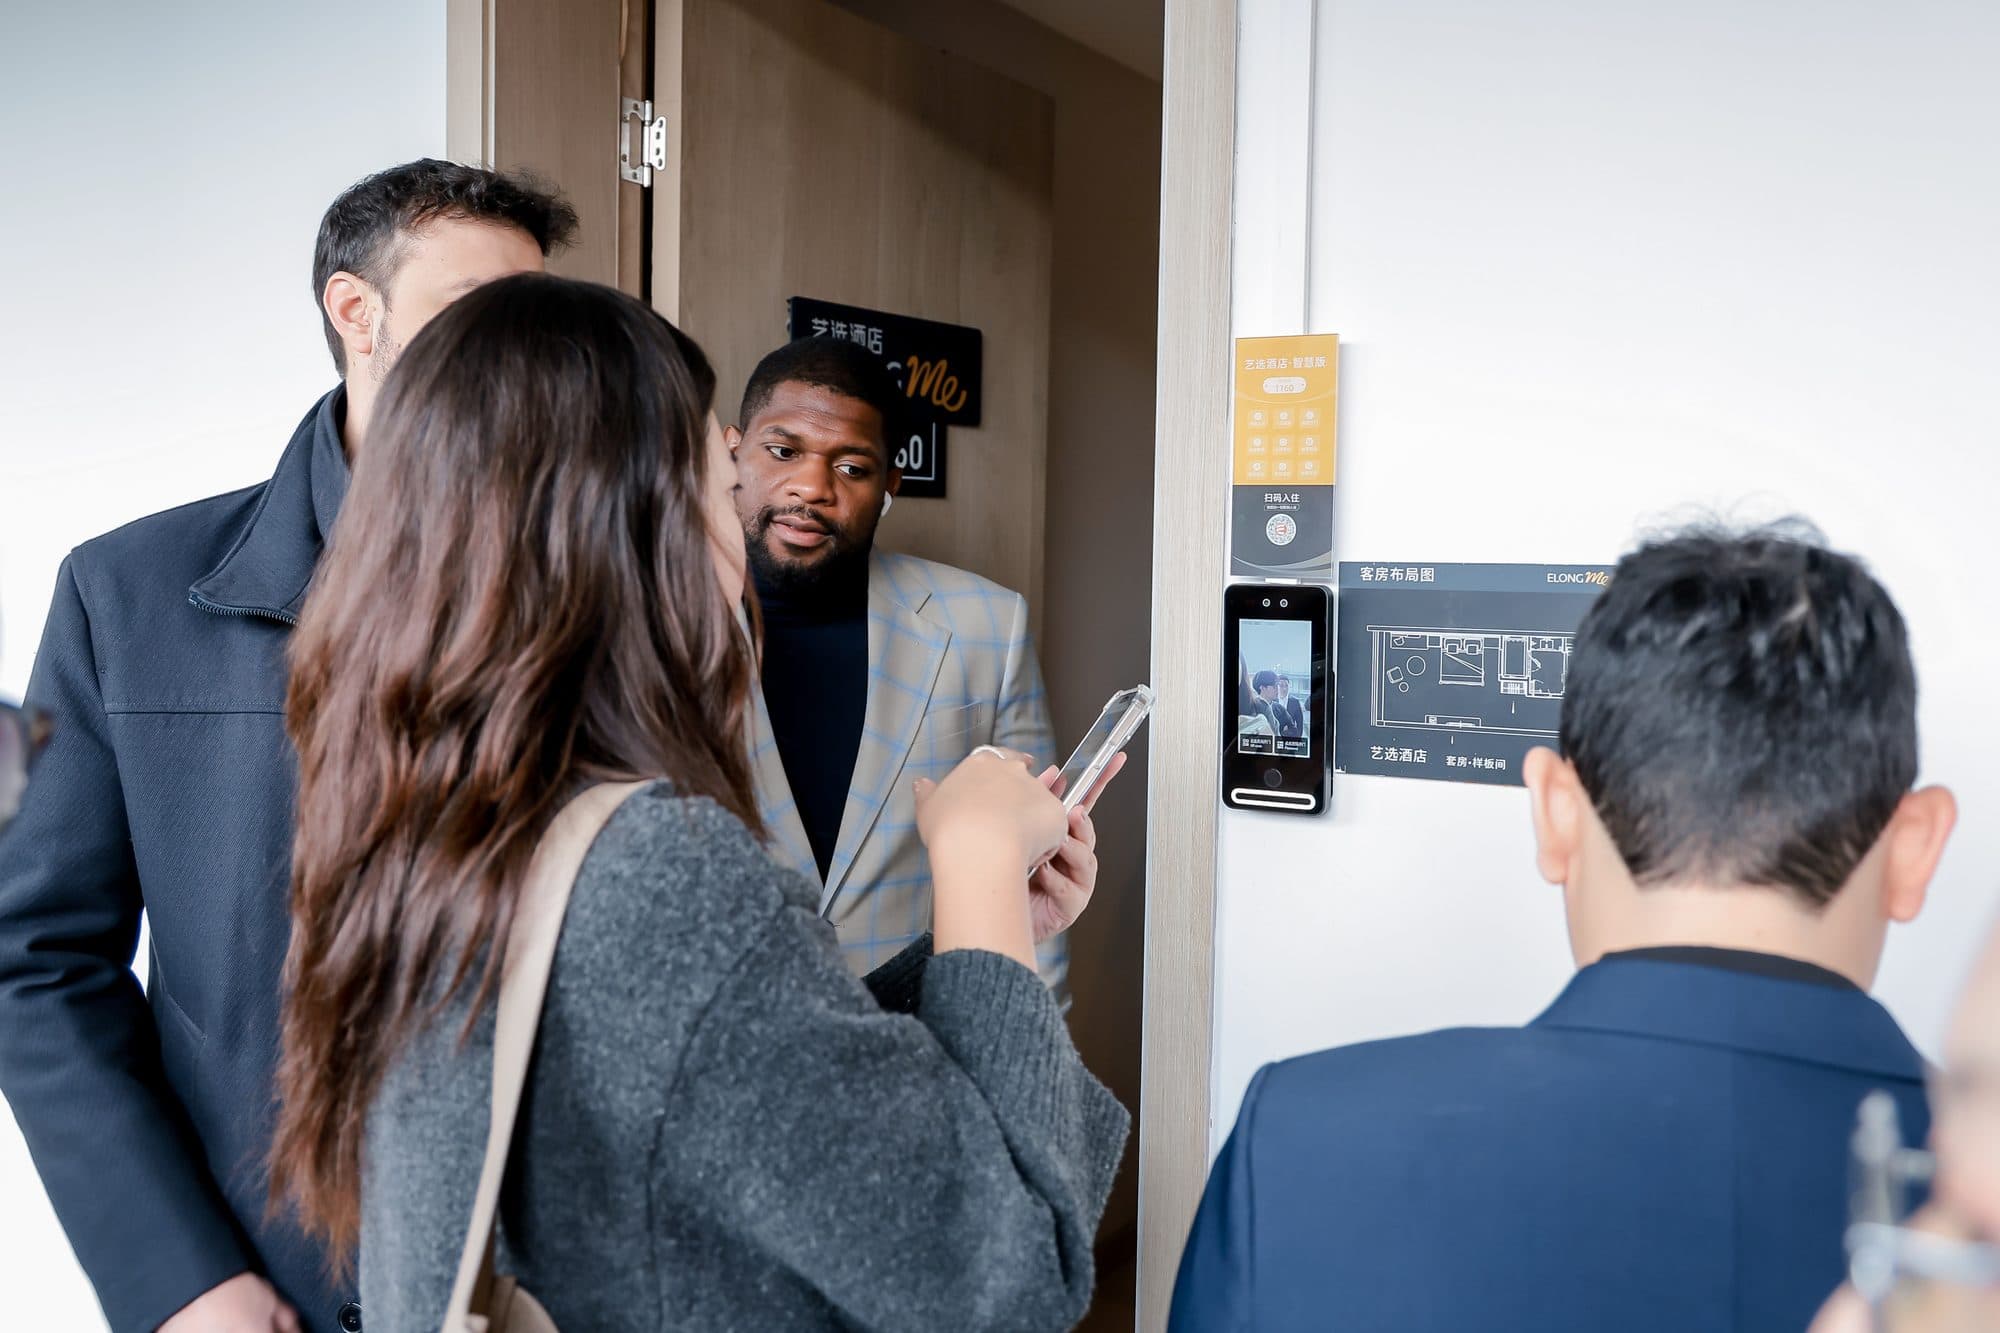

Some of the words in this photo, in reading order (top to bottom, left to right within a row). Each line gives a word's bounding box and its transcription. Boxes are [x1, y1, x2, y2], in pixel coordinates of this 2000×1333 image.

[1264, 493, 1300, 503] 扫码入住
[1360, 566, 1435, 583] 客房布局图
[1370, 745, 1428, 763] 艺选酒店
